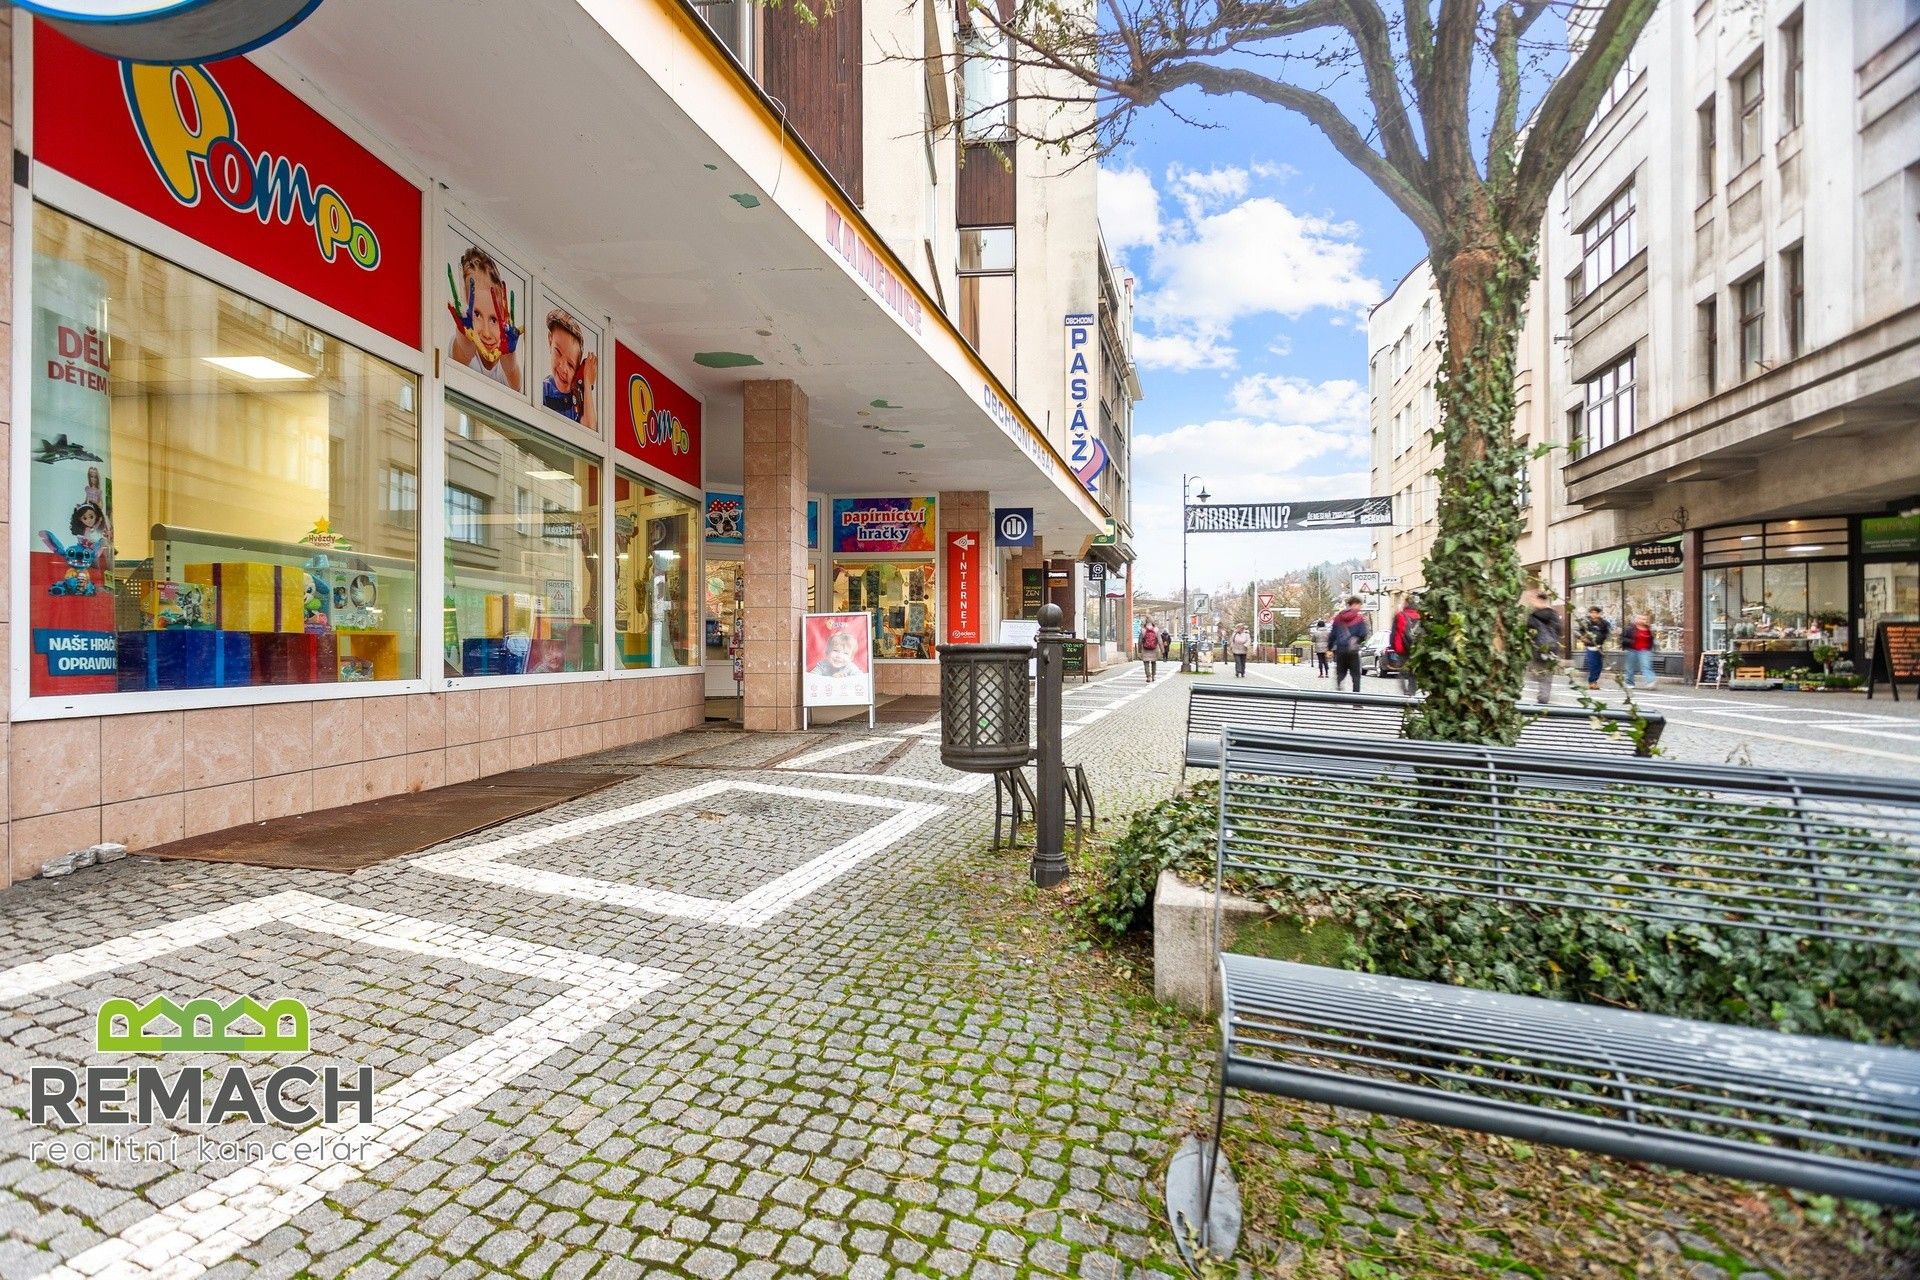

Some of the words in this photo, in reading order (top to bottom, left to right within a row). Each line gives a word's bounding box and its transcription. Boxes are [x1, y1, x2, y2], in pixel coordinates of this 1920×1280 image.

[118, 61, 381, 271] Pompo
[826, 201, 922, 336] KAMENICE
[1066, 316, 1093, 326] OBCHODNÍ
[628, 373, 689, 455] Pompo
[984, 384, 1030, 450] OBCHODNÍ
[1070, 328, 1088, 461] PASÁŽ
[857, 526, 909, 542] hračky
[49, 634, 89, 651] NAŠE
[58, 657, 112, 670] OPRAVDU
